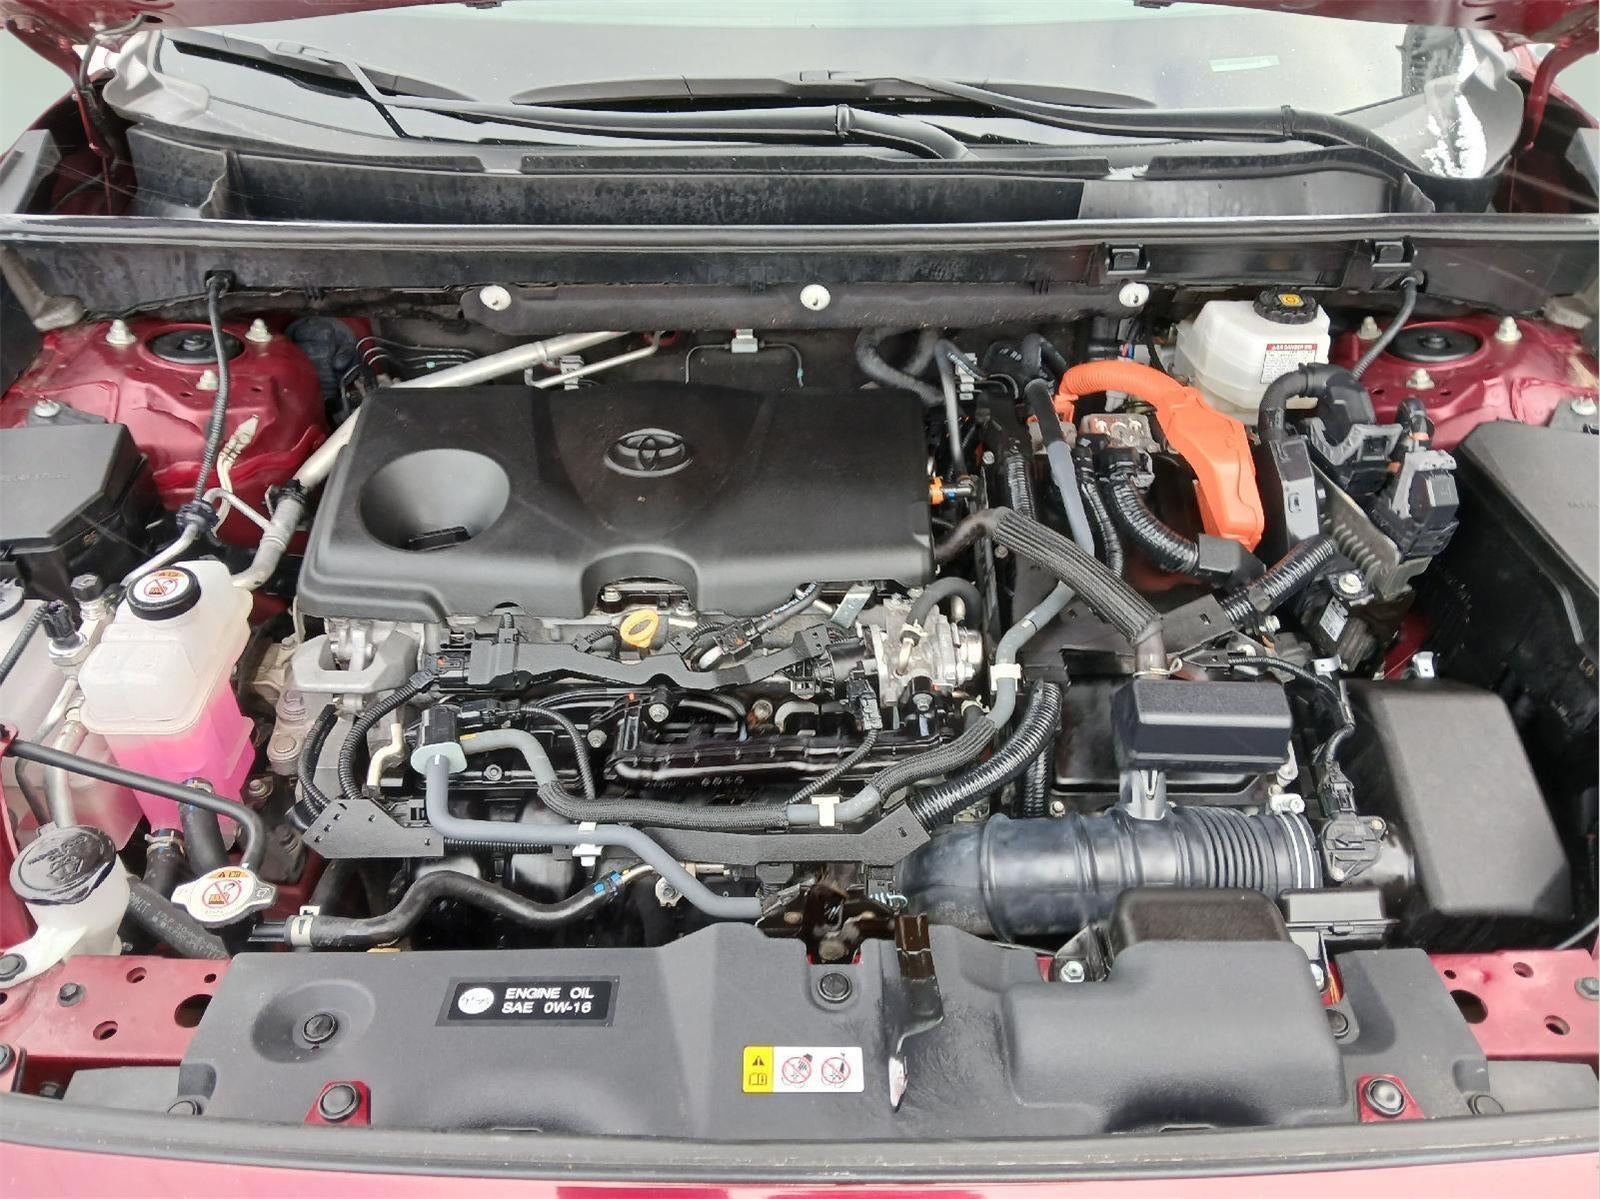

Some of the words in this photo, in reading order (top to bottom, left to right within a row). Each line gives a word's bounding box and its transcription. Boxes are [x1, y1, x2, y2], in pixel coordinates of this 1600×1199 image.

[505, 987, 560, 999] ENGINE
[570, 987, 594, 999] OIL
[502, 1002, 534, 1013] SAE
[544, 1002, 592, 1013] 0W-16
